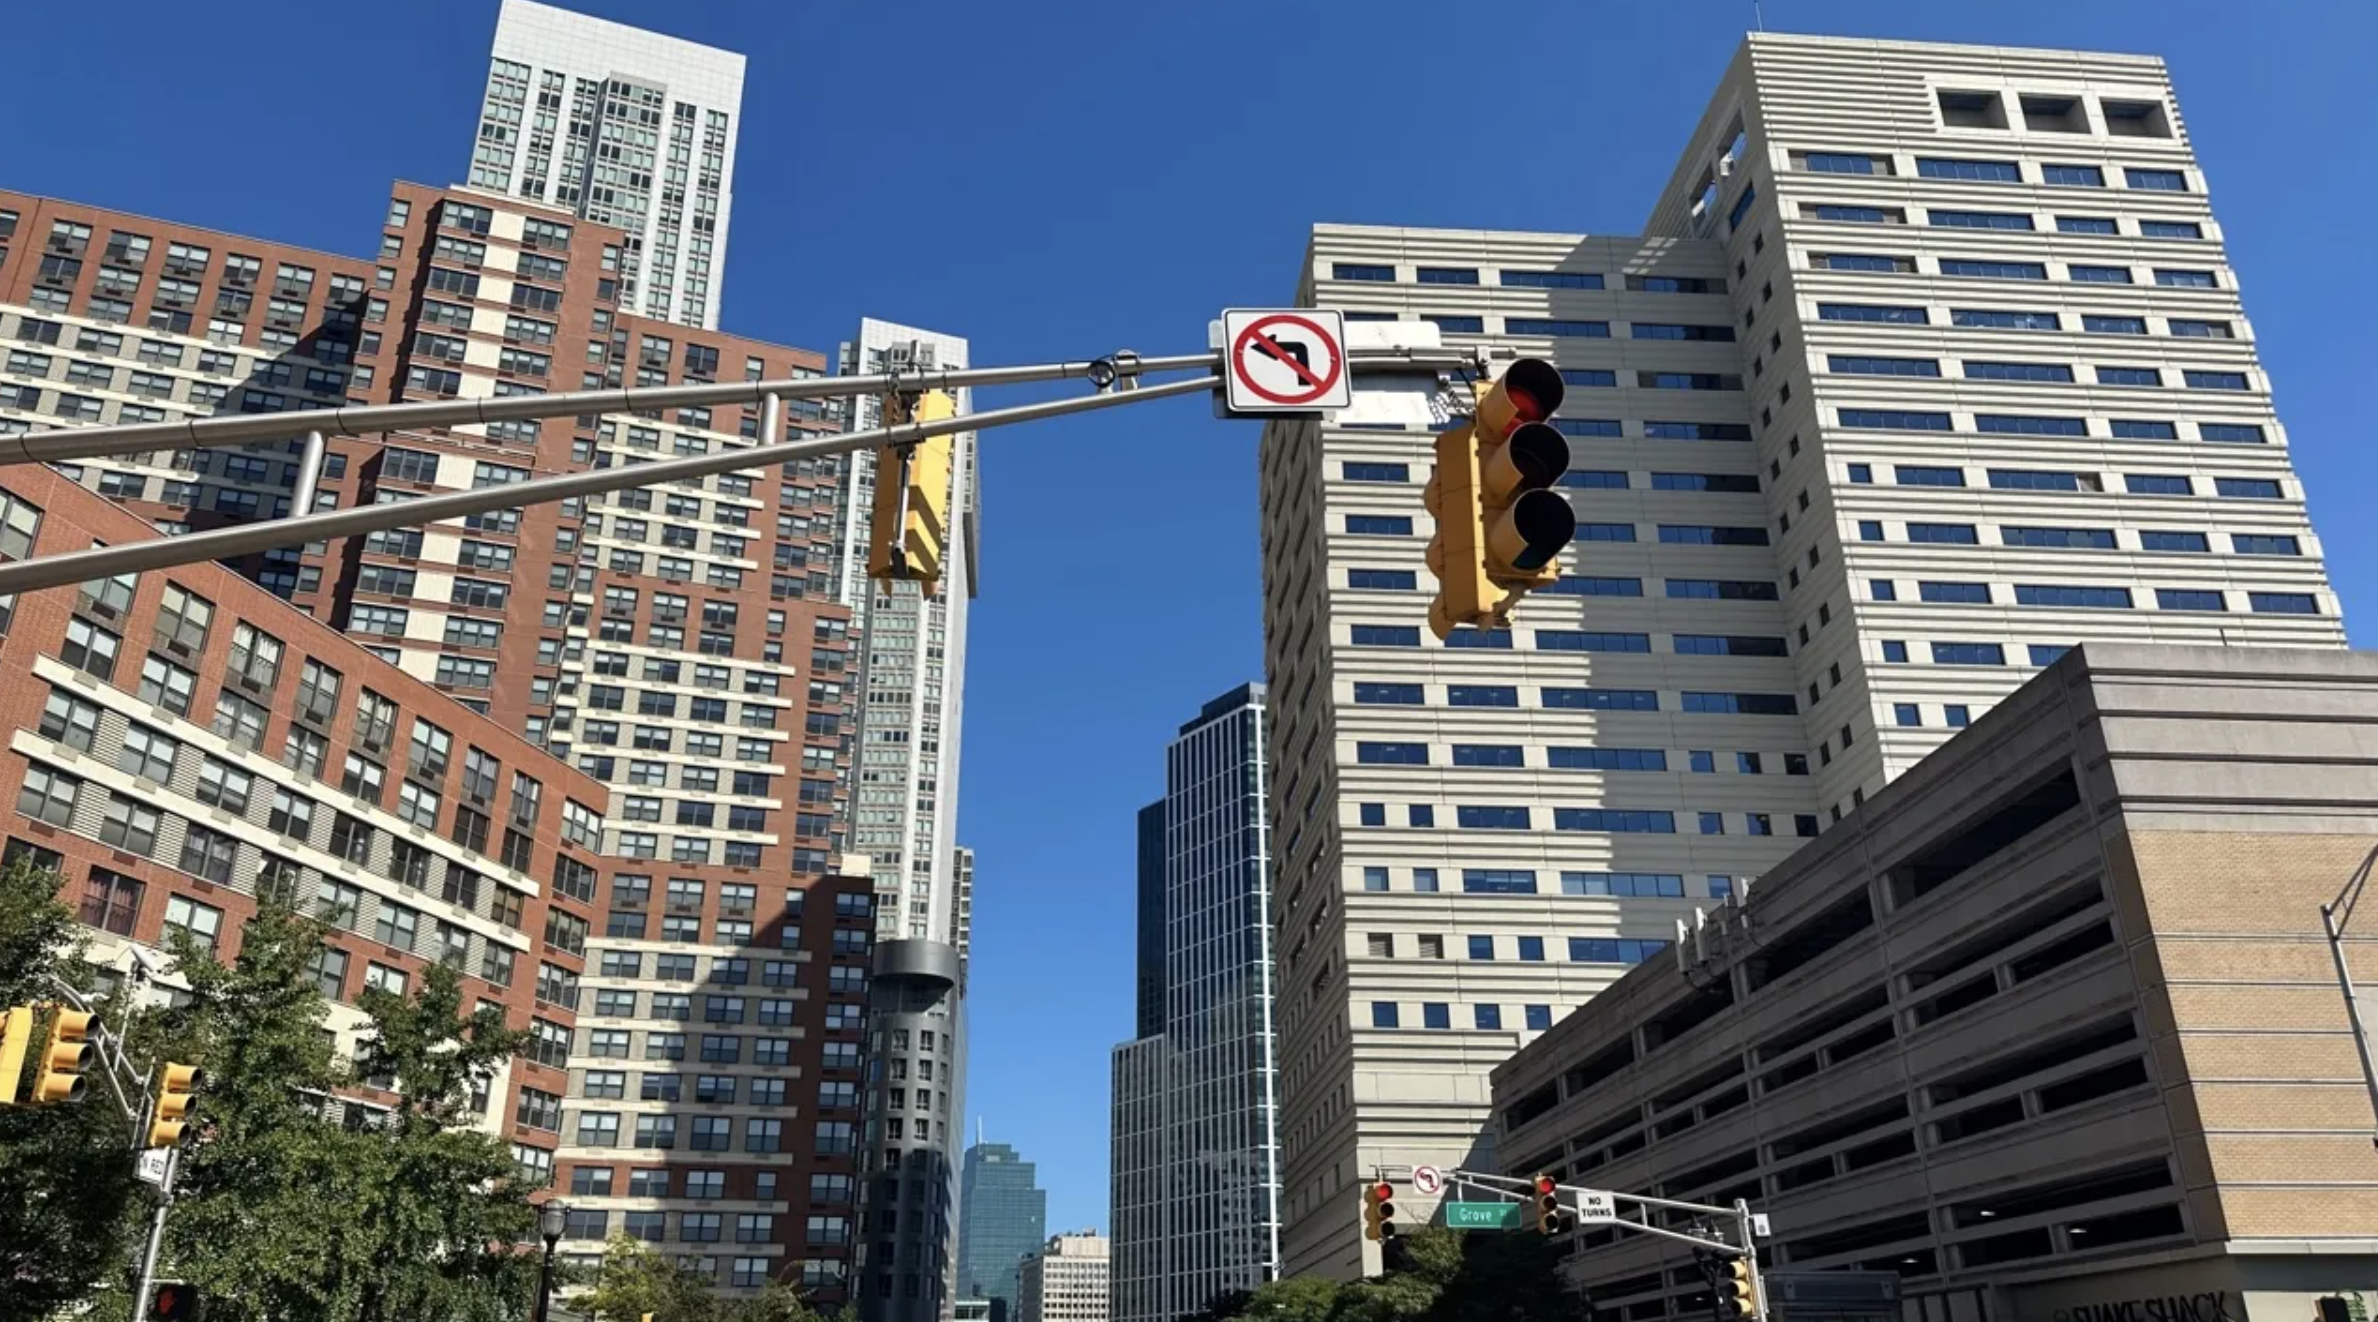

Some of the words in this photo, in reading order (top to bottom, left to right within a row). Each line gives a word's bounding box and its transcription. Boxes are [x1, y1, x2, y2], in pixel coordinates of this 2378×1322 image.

[1588, 1196, 1601, 1205] NO
[1460, 1207, 1492, 1221] Grove
[1582, 1208, 1612, 1217] TURNS
[2145, 1291, 2231, 1322] SHACK
